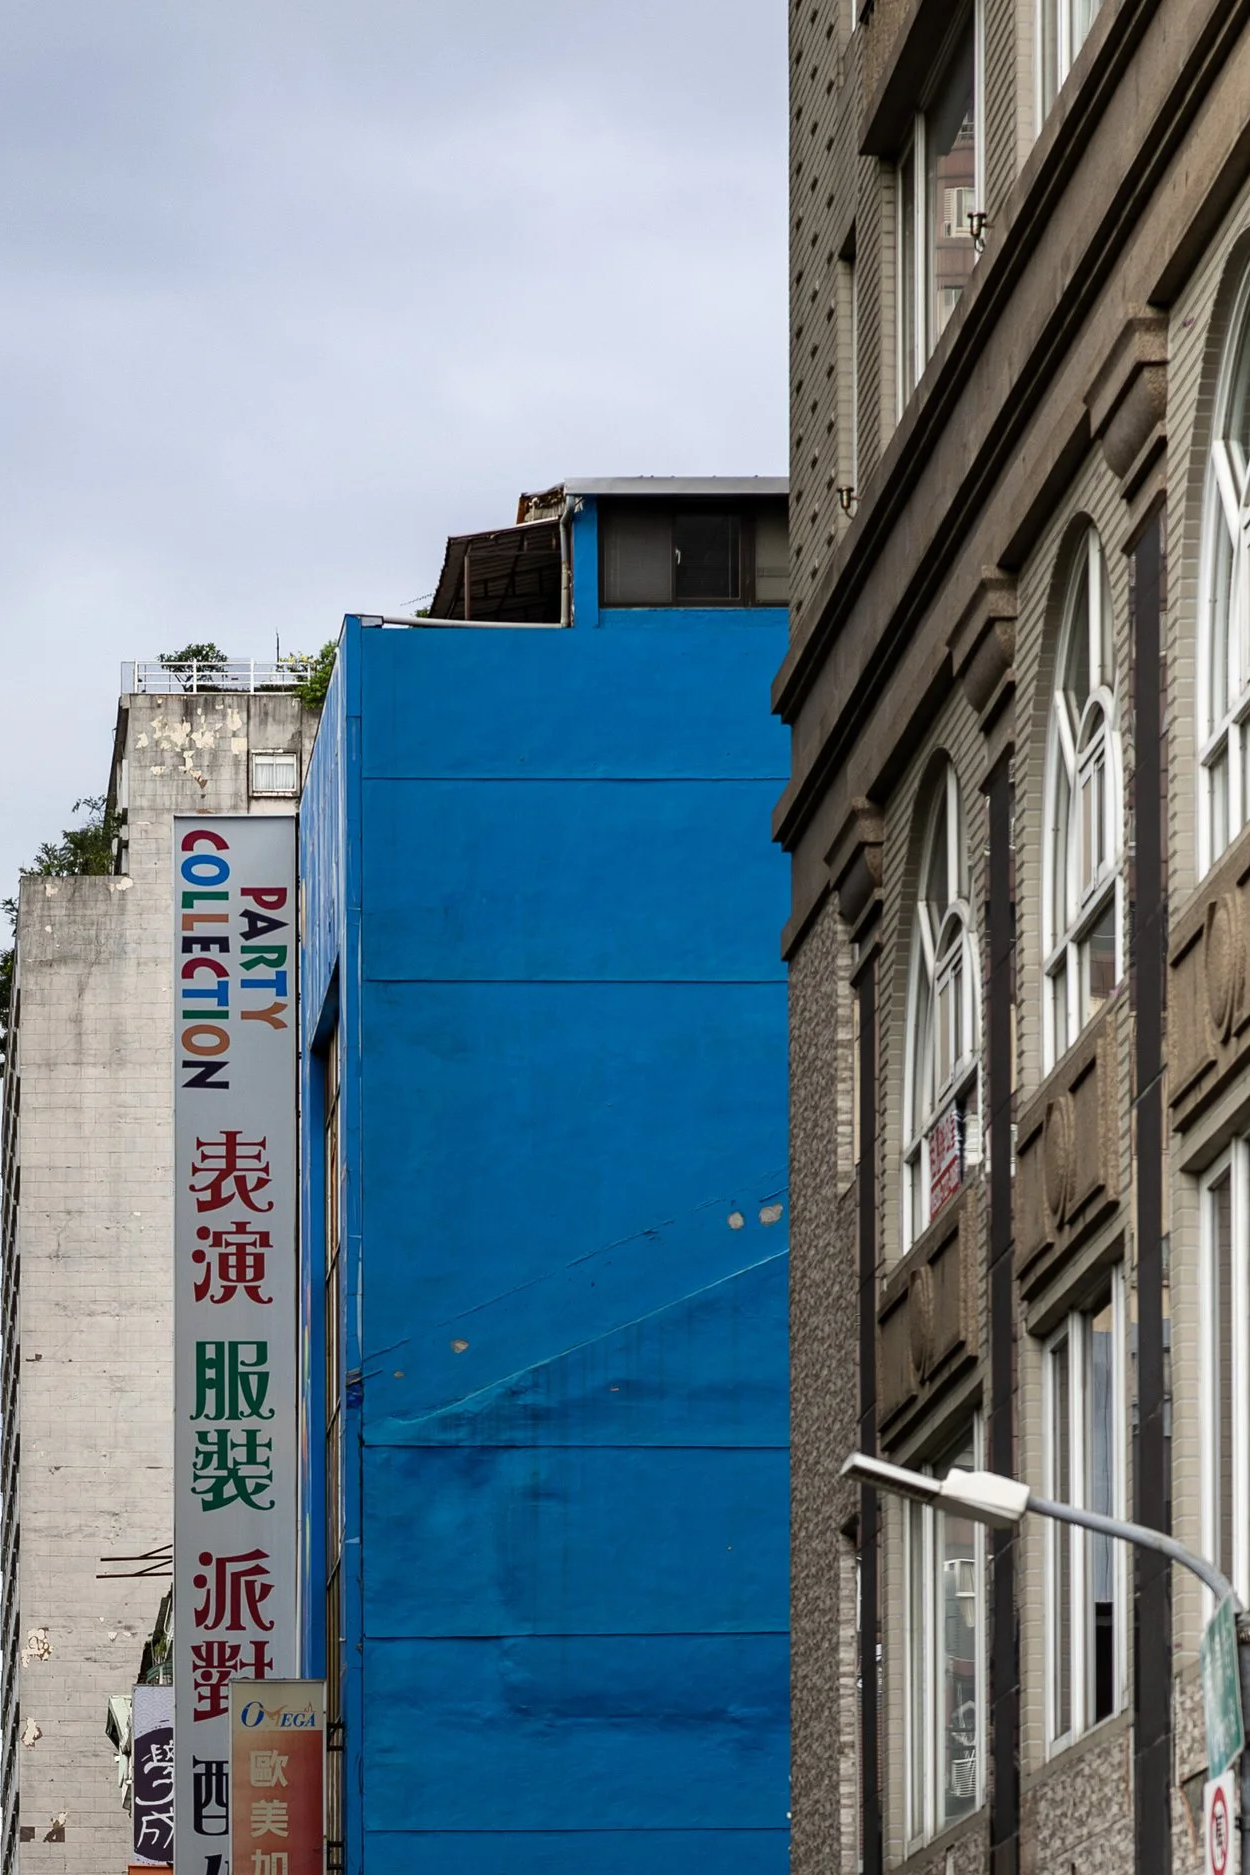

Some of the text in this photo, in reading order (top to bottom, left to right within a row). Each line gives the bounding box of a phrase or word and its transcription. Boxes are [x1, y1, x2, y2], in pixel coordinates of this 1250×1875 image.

[181, 829, 230, 1090] COLLECTION
[240, 886, 289, 1030] PARTY
[188, 1130, 275, 1305] 表演
[189, 1340, 276, 1513] 服裝
